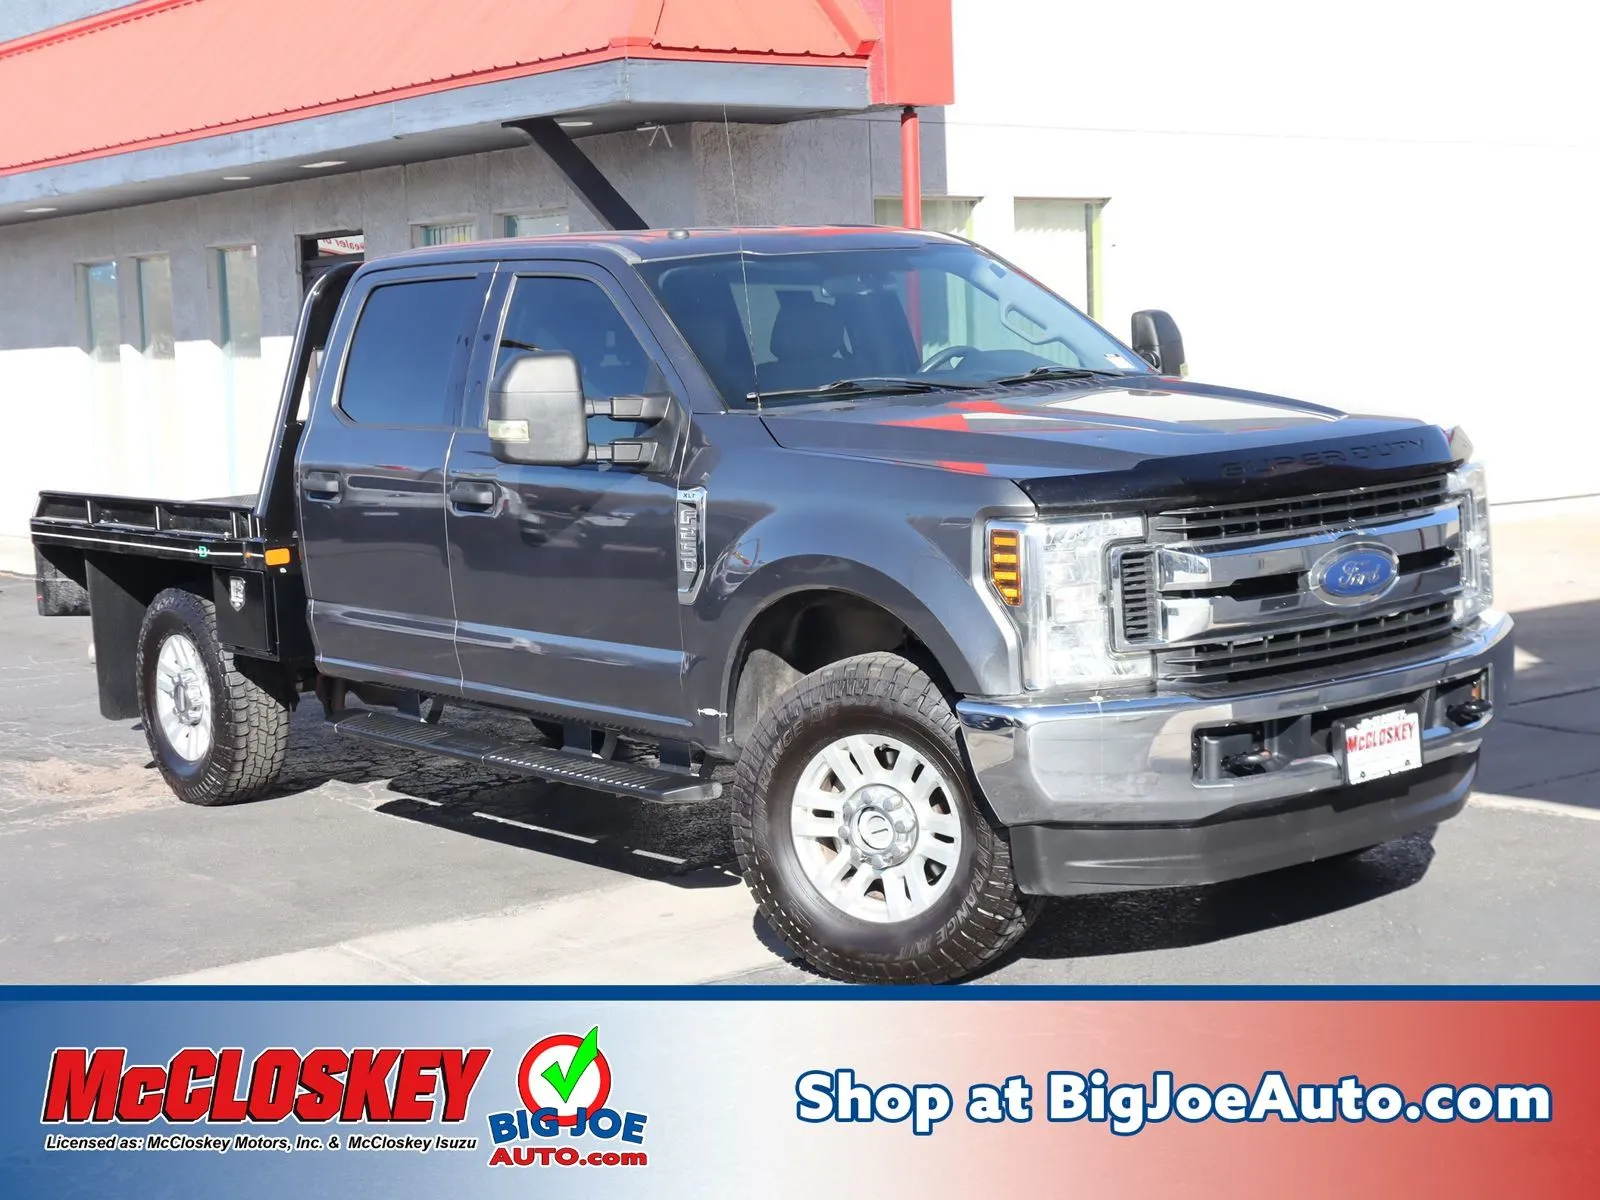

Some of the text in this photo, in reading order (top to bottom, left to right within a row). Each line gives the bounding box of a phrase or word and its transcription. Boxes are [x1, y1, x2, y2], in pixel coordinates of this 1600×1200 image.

[1221, 438, 1424, 478] SUPER DUTY
[1338, 559, 1381, 586] Ford
[757, 720, 805, 793] RANGE
[935, 867, 986, 946] RANGE
